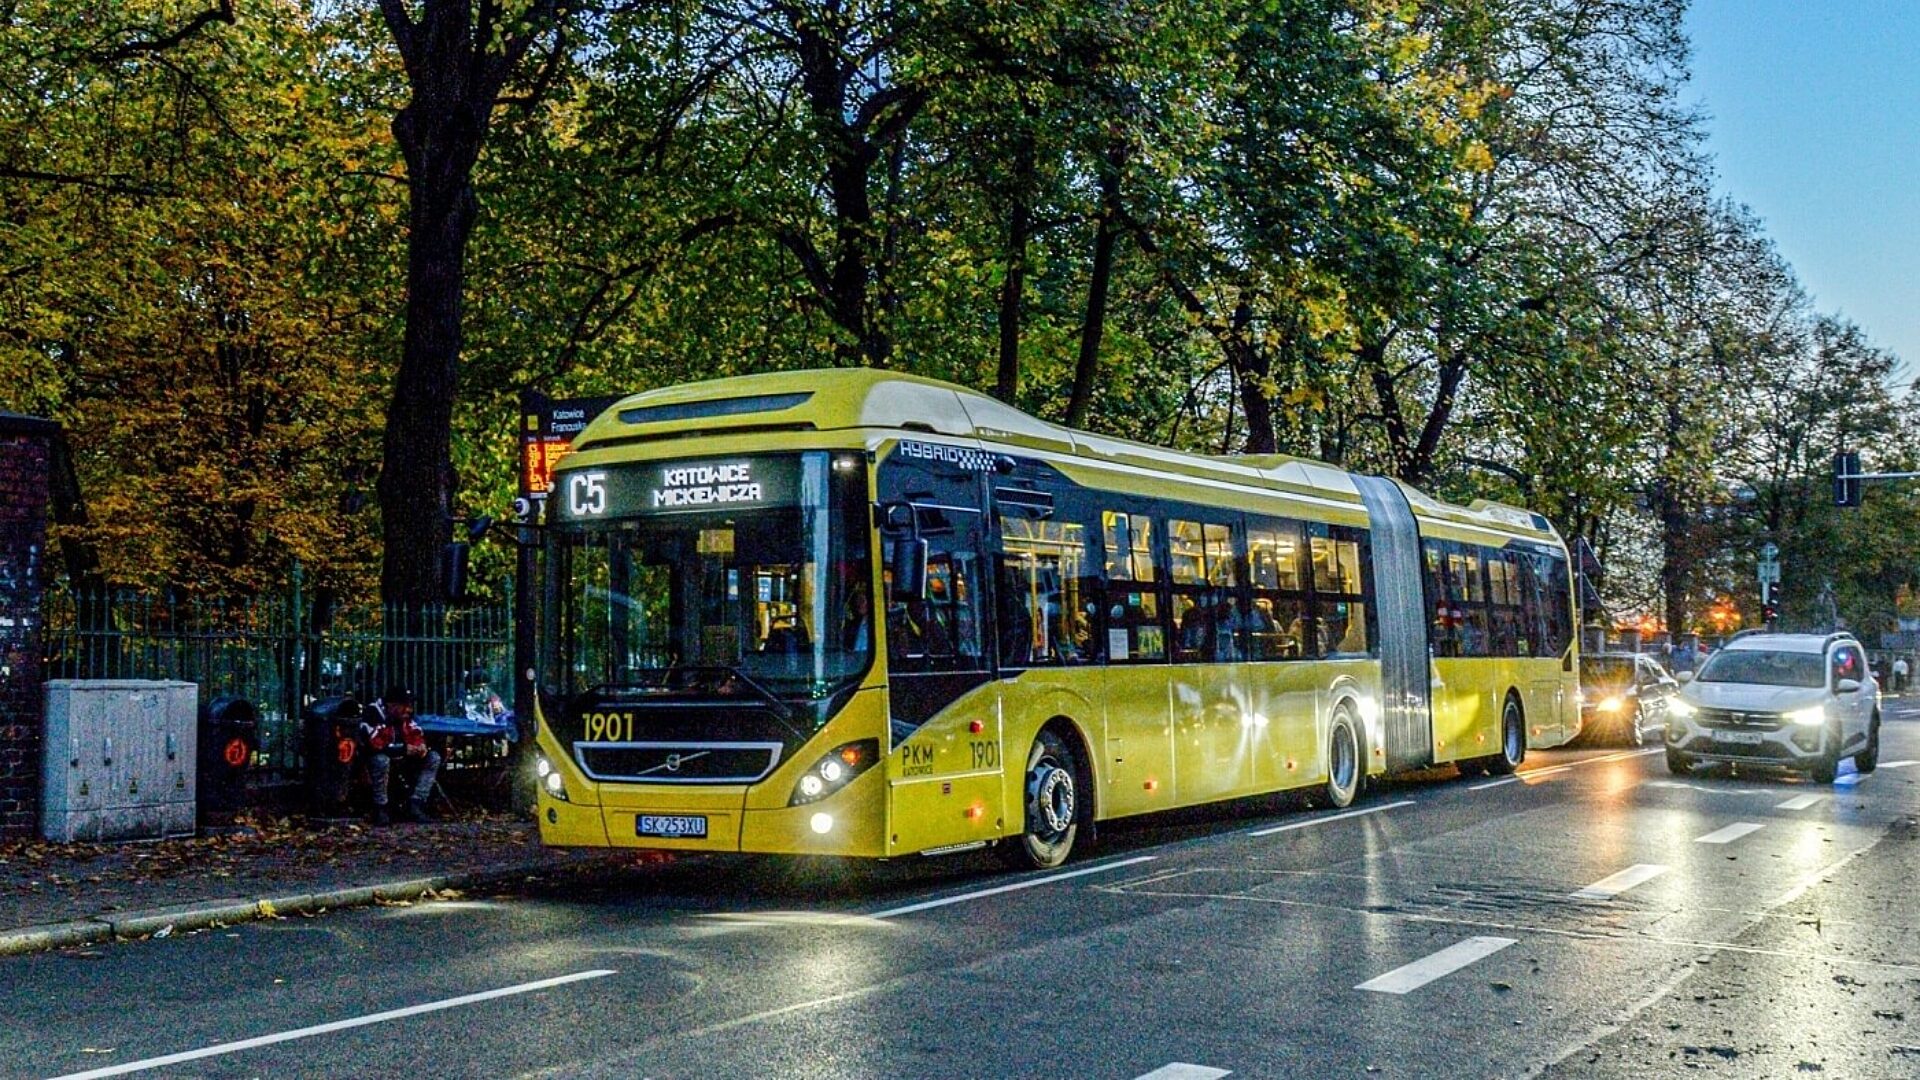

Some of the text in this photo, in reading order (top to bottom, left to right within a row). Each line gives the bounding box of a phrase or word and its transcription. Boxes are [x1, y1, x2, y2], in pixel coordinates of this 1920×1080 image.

[553, 409, 585, 420] Katowice
[900, 440, 959, 463] HYBRID
[664, 464, 751, 487] KATOWICE
[569, 472, 606, 516] C5
[653, 482, 762, 508] MICKIEWICZA
[582, 712, 633, 742] 1901
[902, 744, 934, 766] PKM
[969, 740, 1001, 769] 1901
